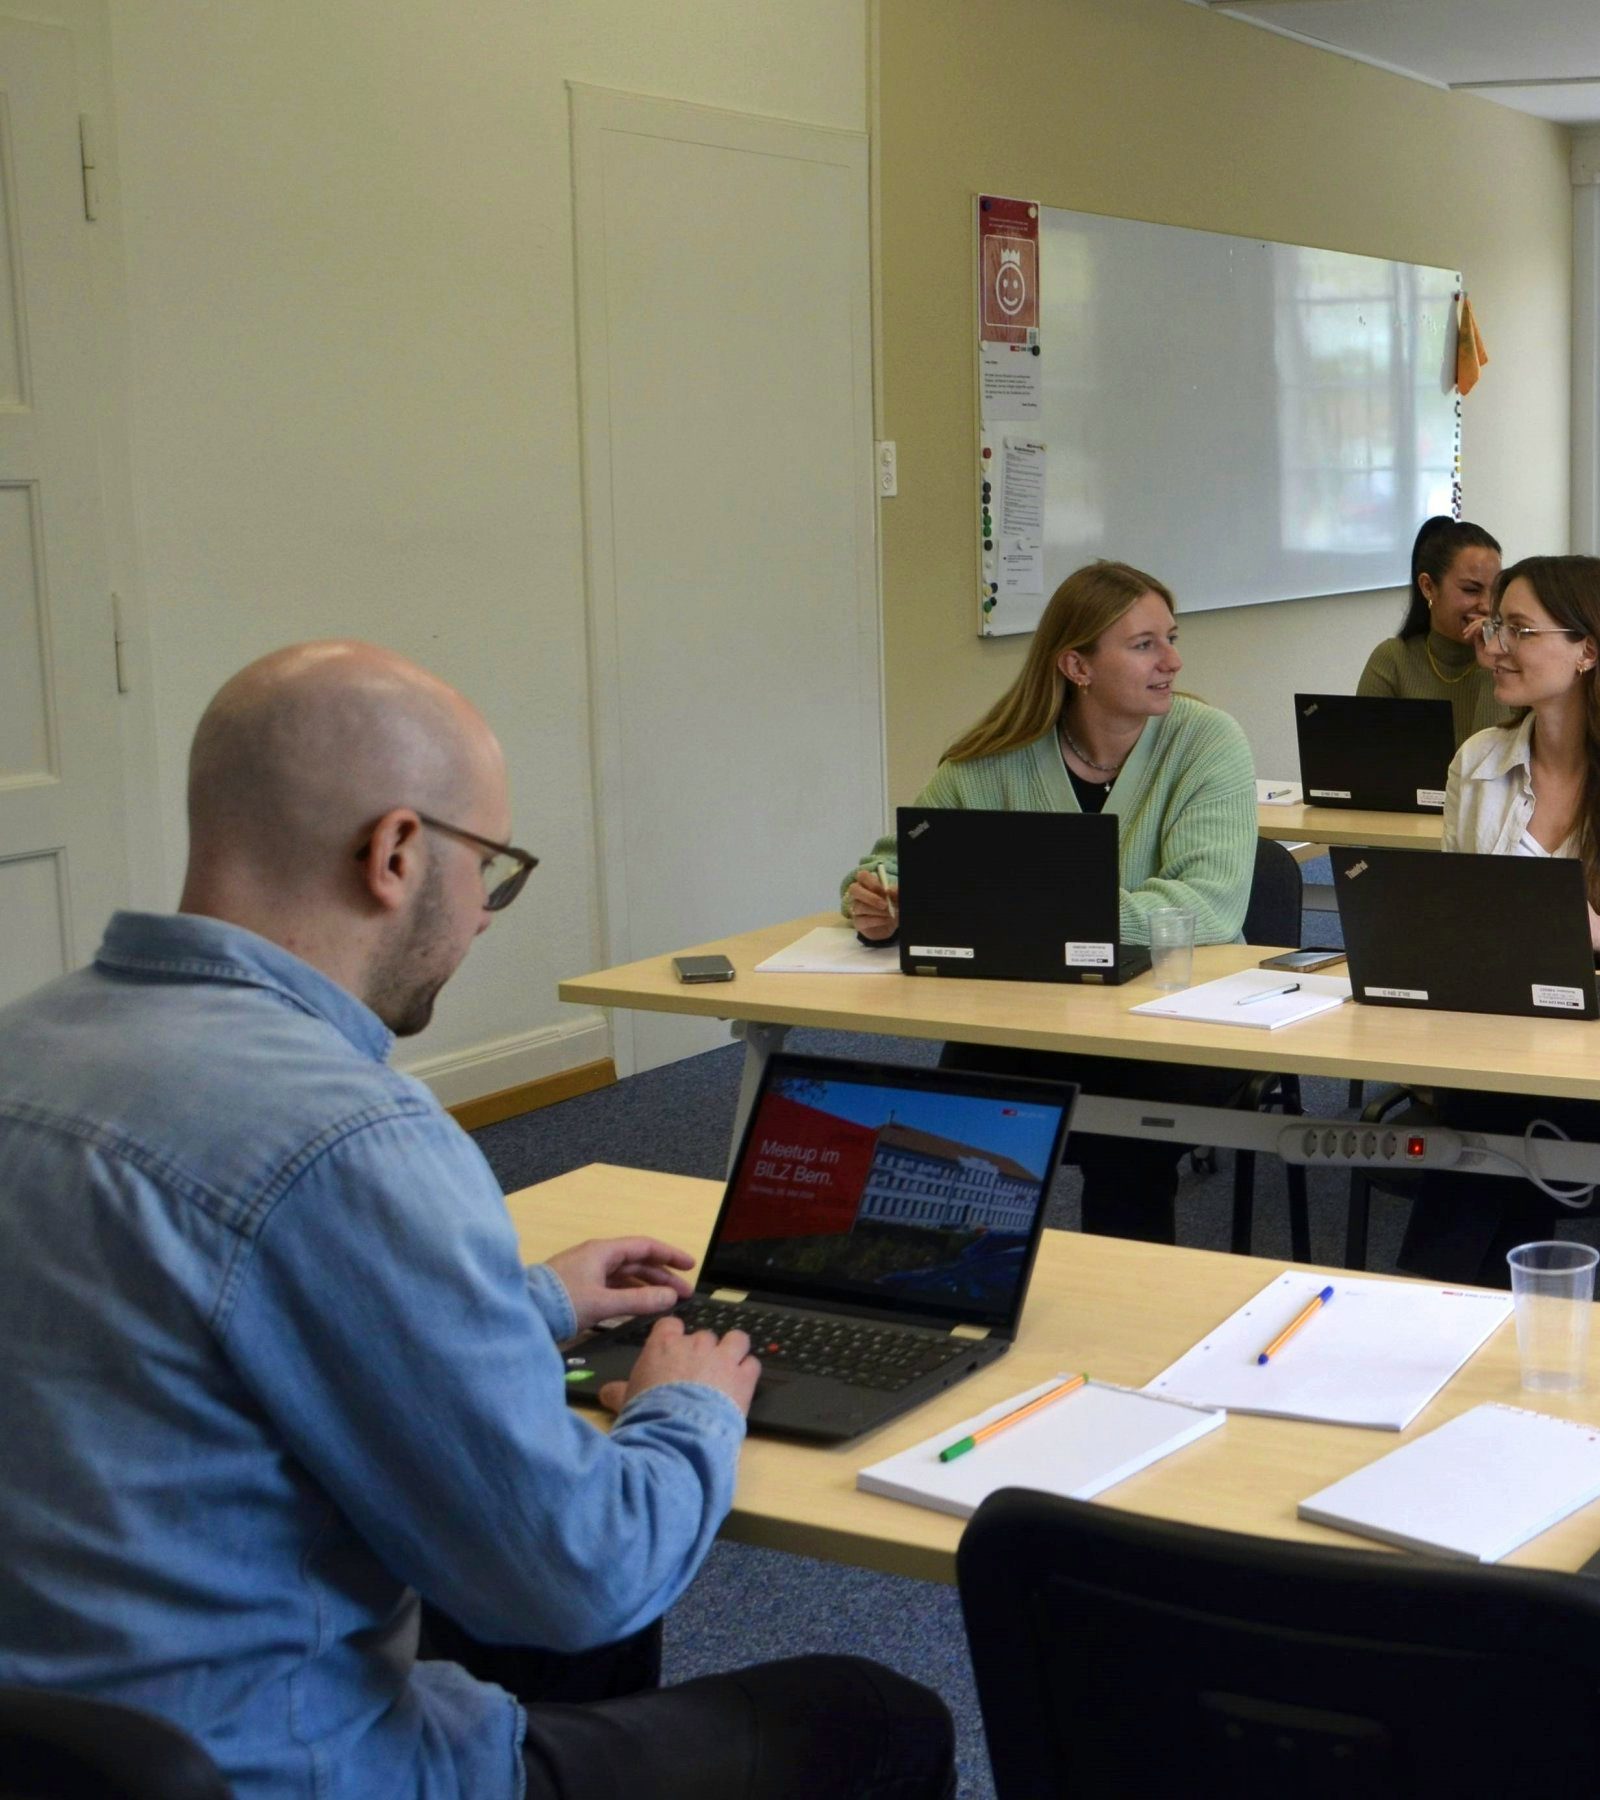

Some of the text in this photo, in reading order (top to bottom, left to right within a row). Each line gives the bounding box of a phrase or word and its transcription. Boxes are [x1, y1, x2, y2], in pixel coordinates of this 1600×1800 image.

[761, 1139, 840, 1165] Meetup im
[754, 1161, 833, 1186] BILZ Bern.
